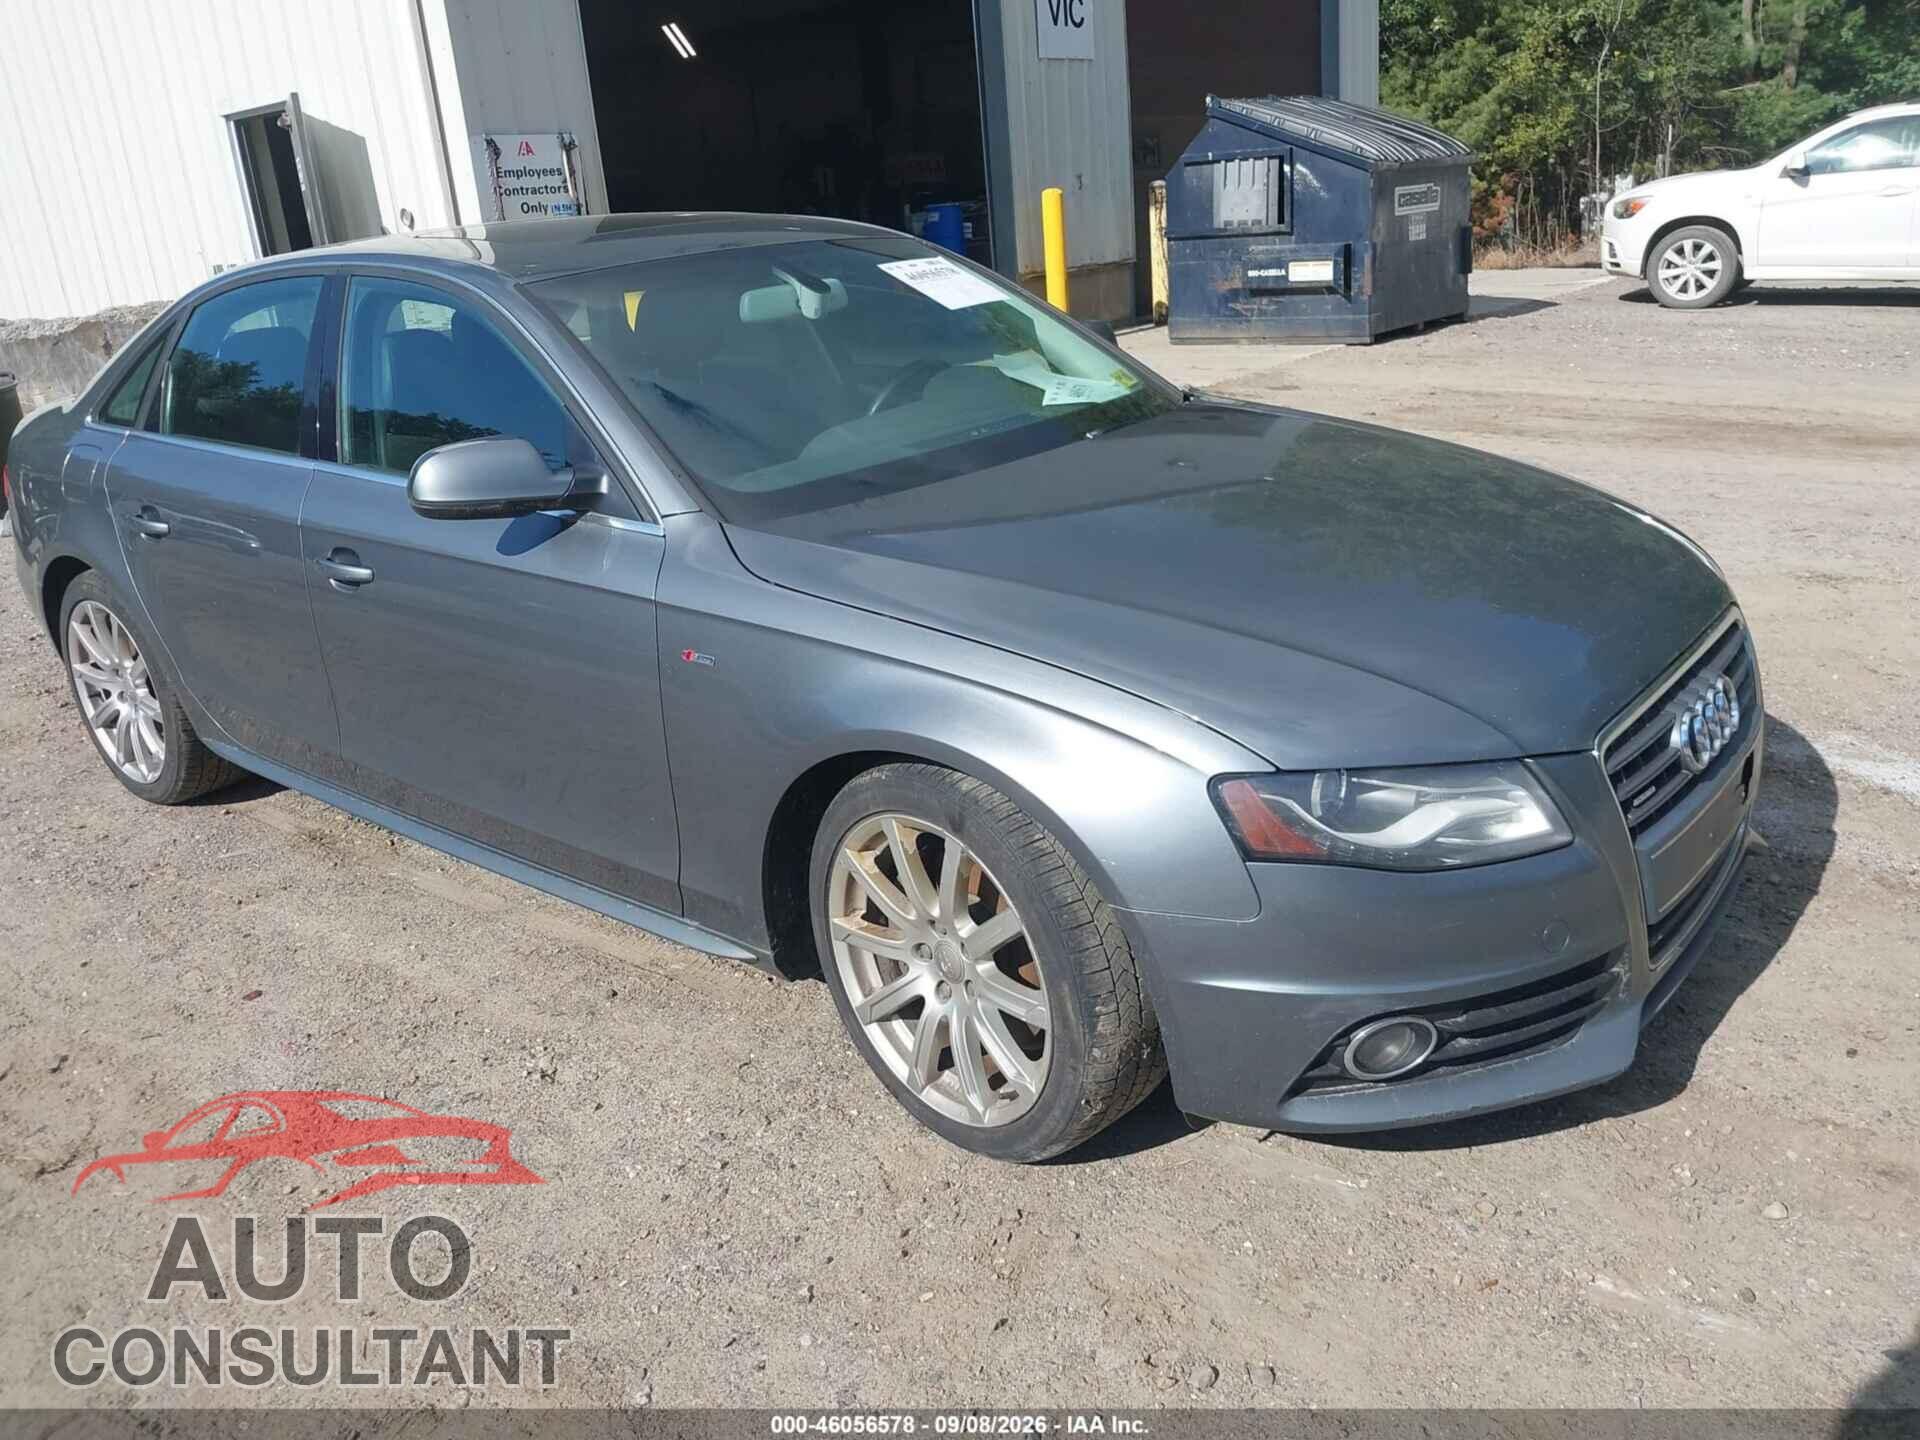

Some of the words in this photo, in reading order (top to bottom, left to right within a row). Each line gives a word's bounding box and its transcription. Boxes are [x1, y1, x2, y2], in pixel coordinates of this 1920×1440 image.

[1047, 0, 1085, 29] VIC
[497, 166, 562, 180] Employees
[520, 201, 549, 215] Only
